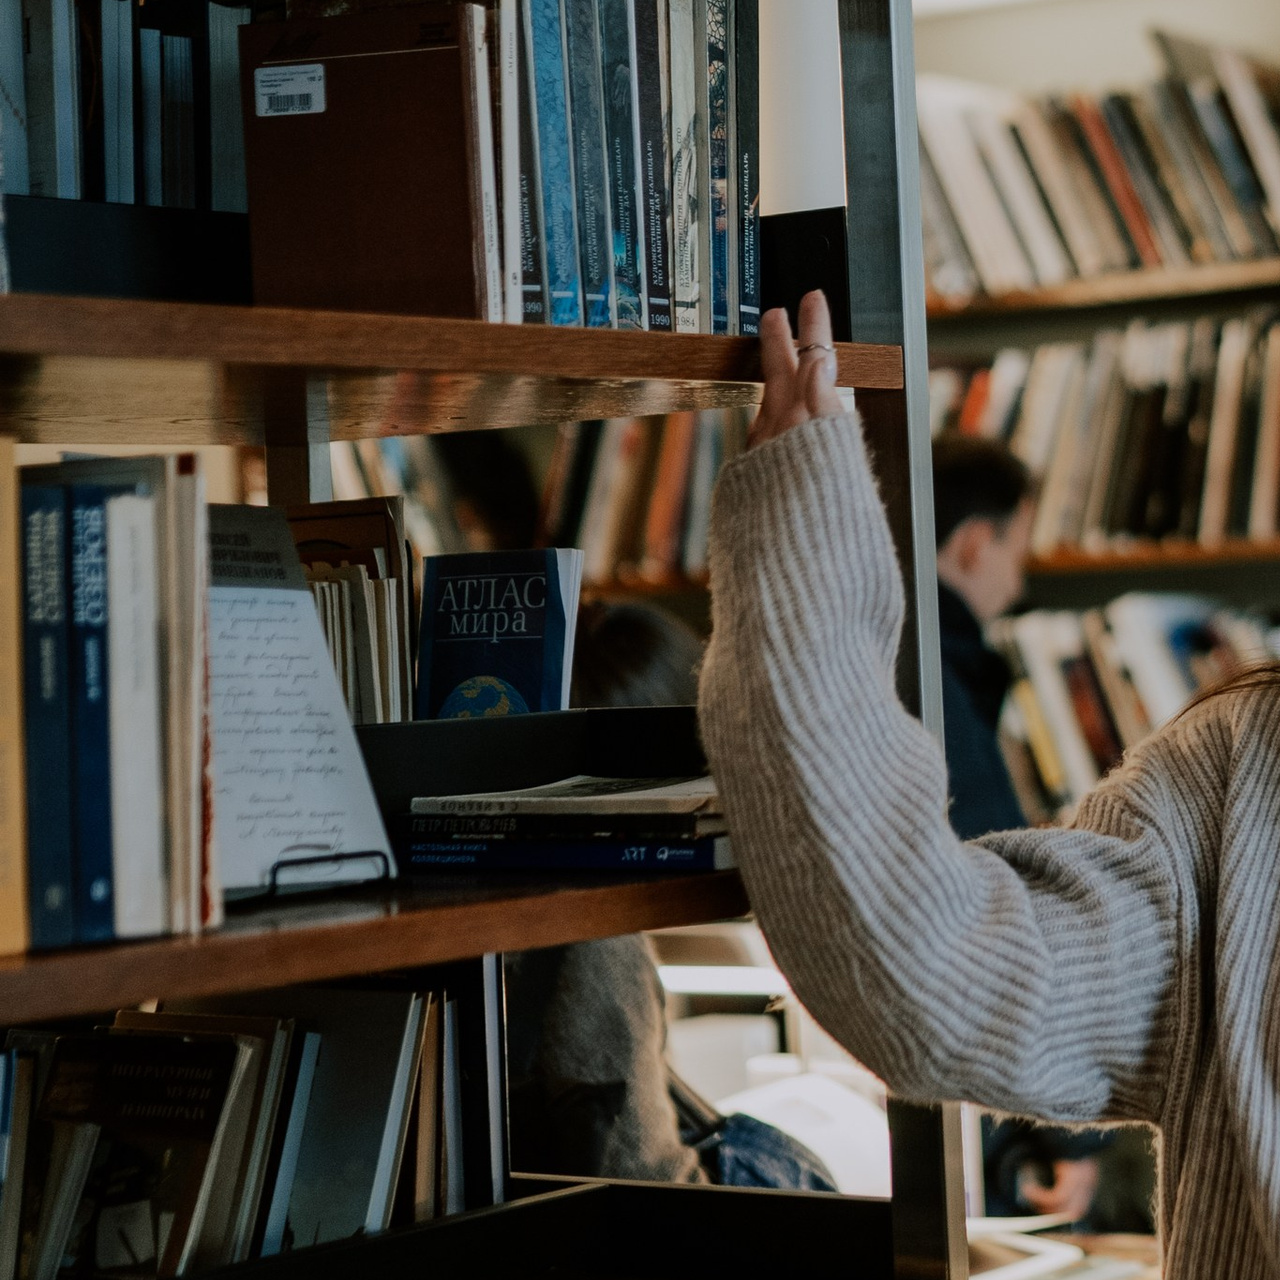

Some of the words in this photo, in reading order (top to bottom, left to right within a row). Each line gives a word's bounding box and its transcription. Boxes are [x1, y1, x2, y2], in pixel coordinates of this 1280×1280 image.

[580, 130, 588, 186] КАЛЕНДАРЬ
[615, 137, 623, 192] КАЛЕНДАРЬ
[646, 140, 654, 195] КАЛЕНДАРЬ
[649, 198, 658, 286] ХУДОЖЕСТВЕННЫЙ
[650, 313, 670, 326] 1990
[677, 316, 695, 327] 1984
[743, 322, 759, 334] 1986
[85, 506, 105, 627] ОЗЕРОВ
[437, 576, 546, 612] АТЛАС
[449, 611, 527, 644] мира
[411, 817, 442, 833] ПЕТР
[463, 843, 488, 852] КНИГА
